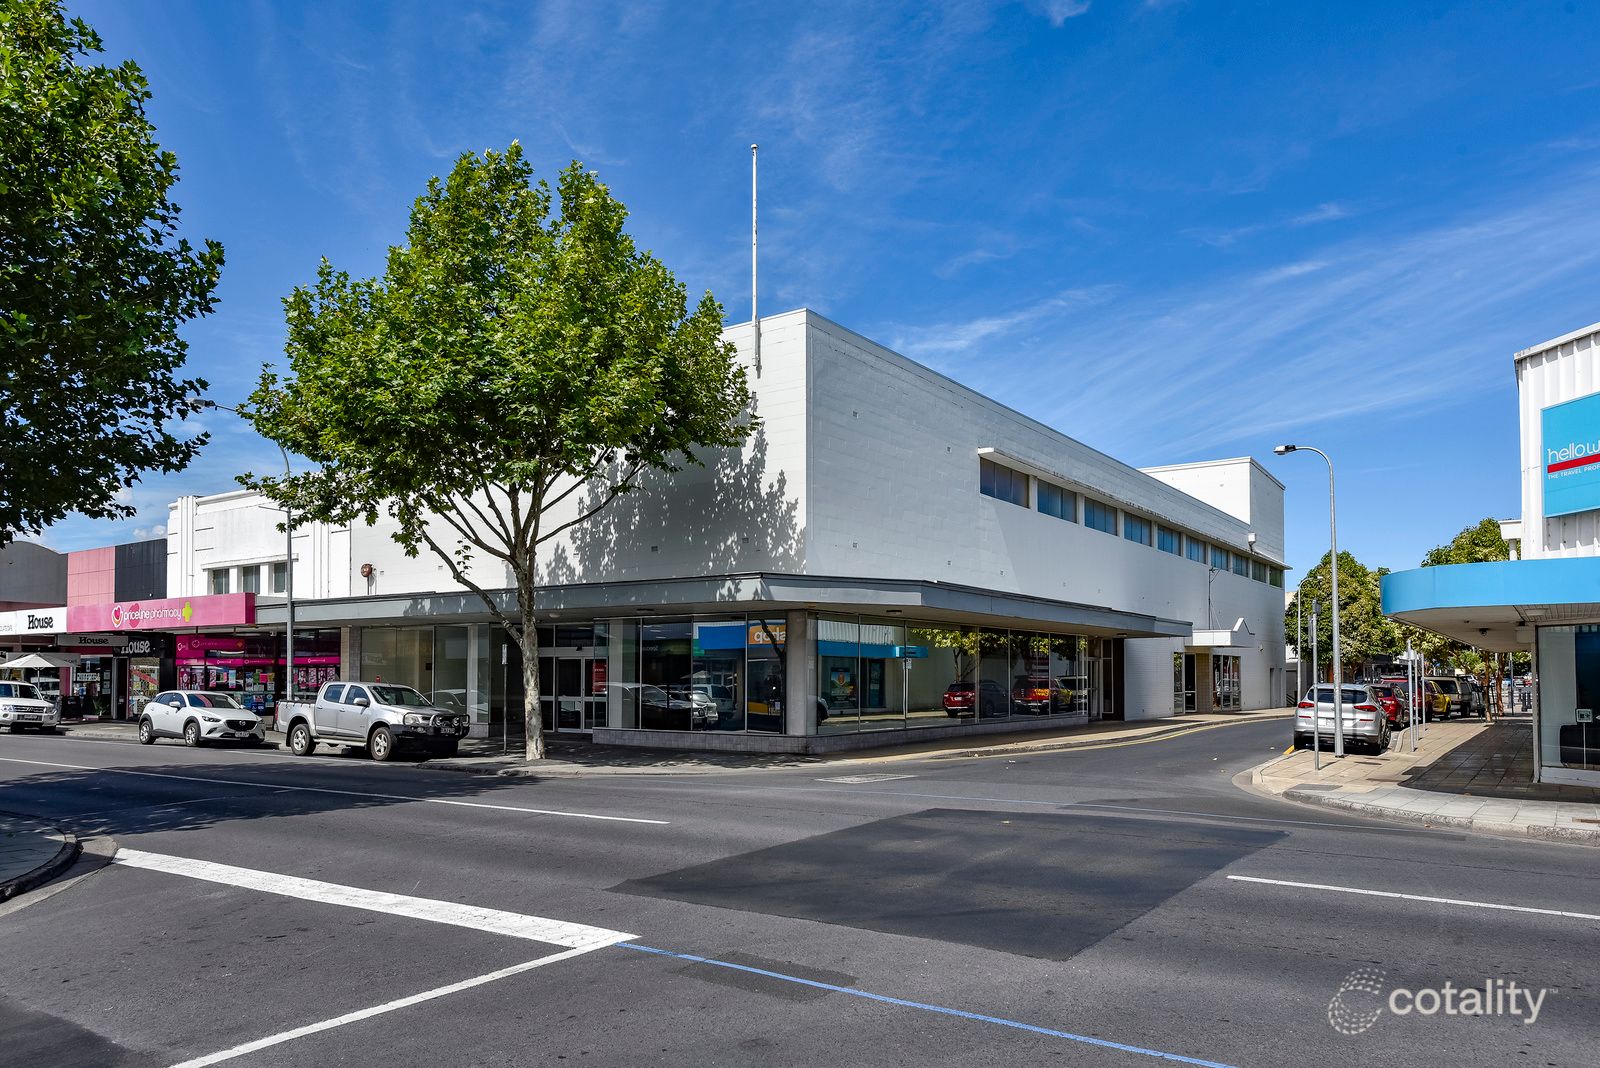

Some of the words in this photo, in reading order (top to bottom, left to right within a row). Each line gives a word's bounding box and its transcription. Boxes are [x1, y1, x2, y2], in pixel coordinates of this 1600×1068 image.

[1561, 469, 1582, 477] TRAVEL
[124, 608, 150, 623] priceline
[150, 607, 182, 621] pharmacy
[27, 614, 54, 630] House
[78, 636, 109, 645] House
